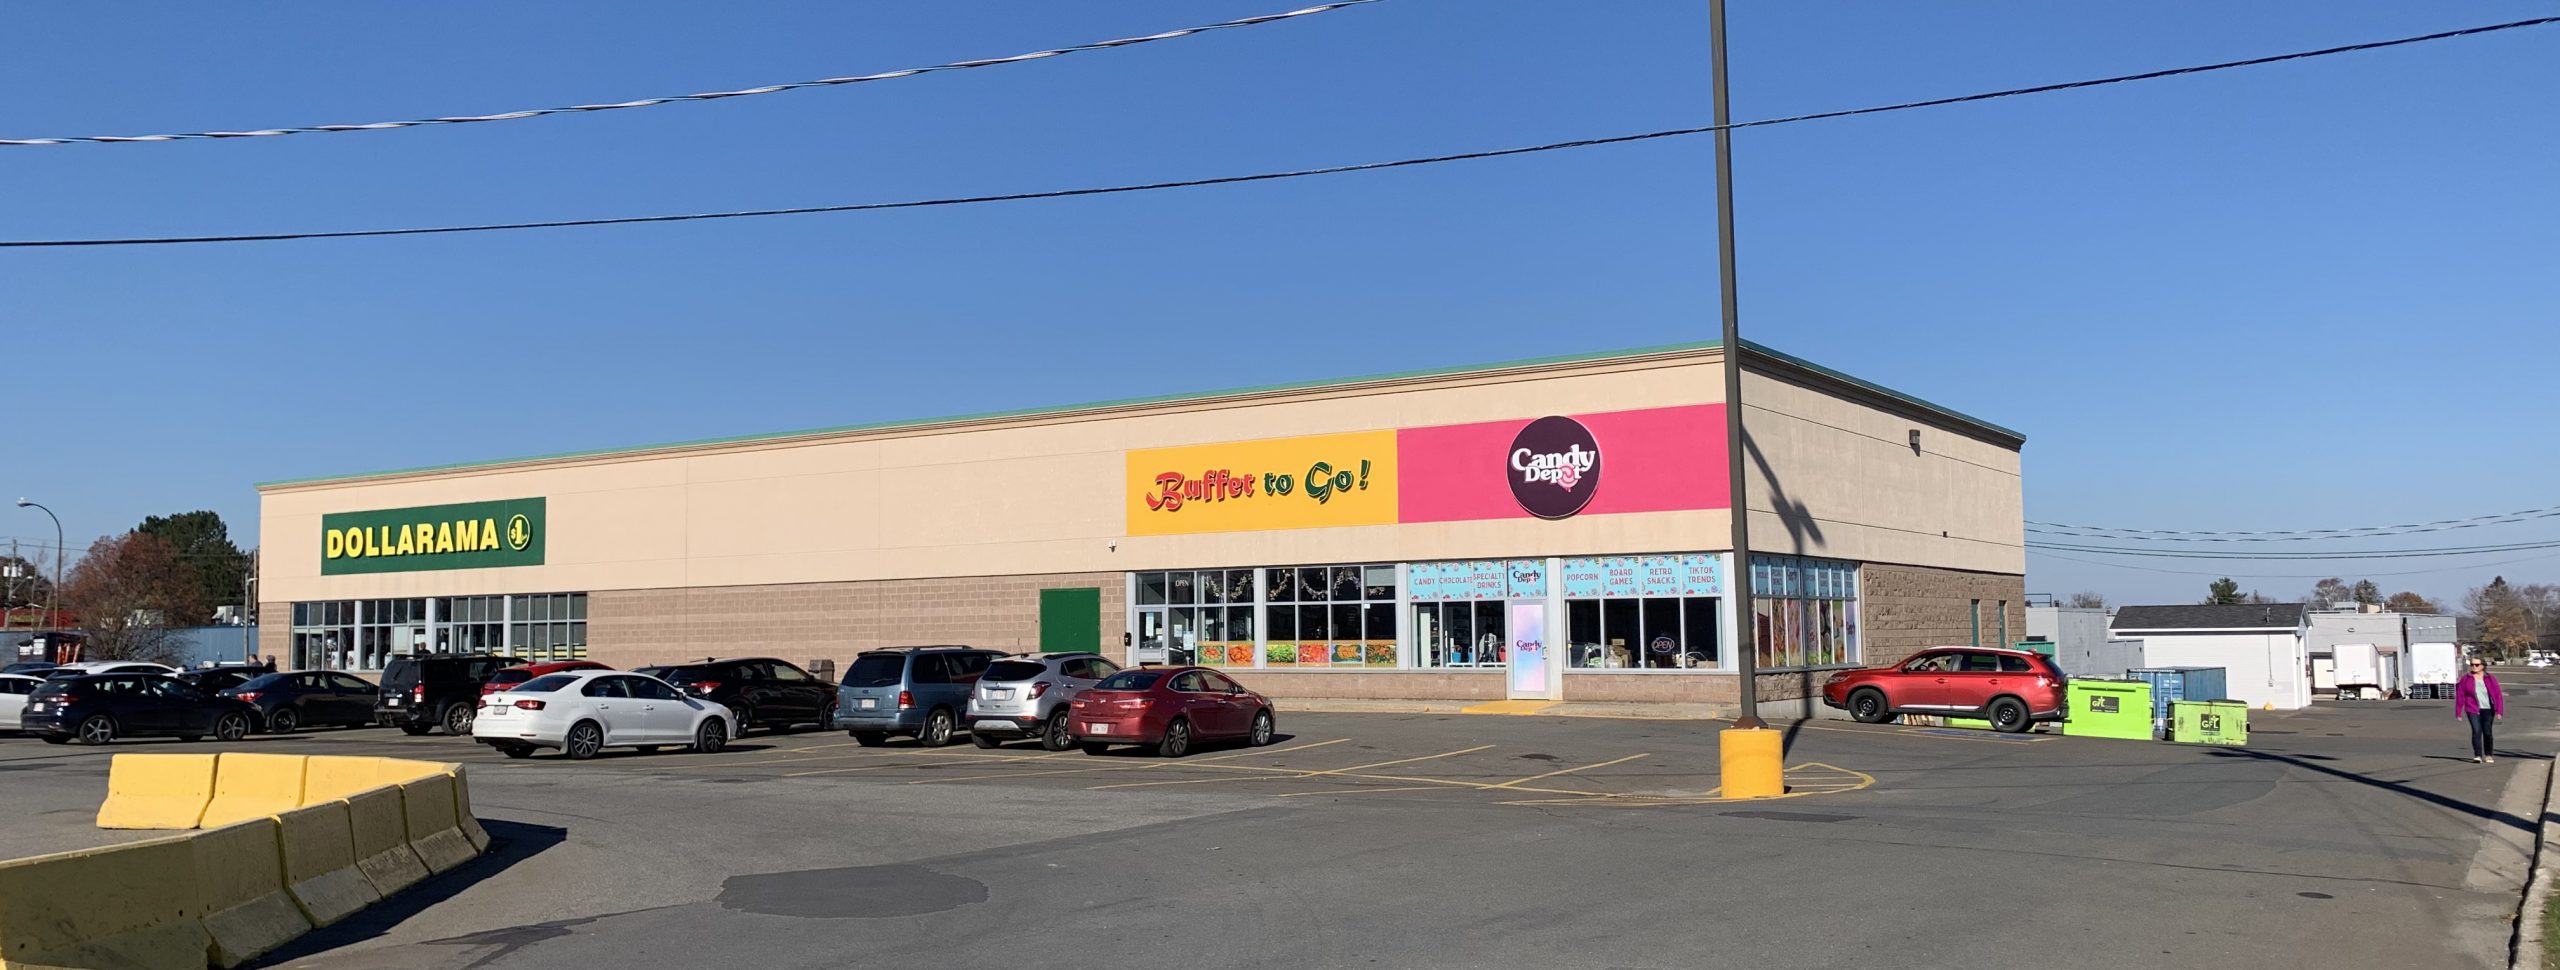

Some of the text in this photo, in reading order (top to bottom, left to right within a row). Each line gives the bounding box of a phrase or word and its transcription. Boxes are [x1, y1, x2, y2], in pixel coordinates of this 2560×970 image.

[1511, 444, 1596, 472] Candy
[1524, 465, 1582, 488] Depot
[1146, 459, 1371, 511] Buffet to Go!
[327, 518, 500, 559] DOLLARAMA
[1512, 569, 1542, 580] Candy
[1609, 568, 1633, 577] BOARD
[1649, 567, 1673, 576] RETRO
[1688, 566, 1714, 575] TIKTOK
[1439, 576, 1473, 584] CHOCOLATE
[1473, 572, 1505, 580] SPECIALTY
[1566, 573, 1599, 581] POPCORN
[1647, 576, 1676, 585] SNACKS
[1688, 575, 1717, 584] TRENDS
[1175, 579, 1190, 588] OPEN
[1414, 577, 1436, 586] CANDY
[1477, 580, 1502, 589] DRINKS
[1609, 577, 1633, 585] GAMES
[1516, 639, 1543, 649] Candy
[1653, 640, 1674, 649] OPEN
[2201, 715, 2219, 729] GFL
